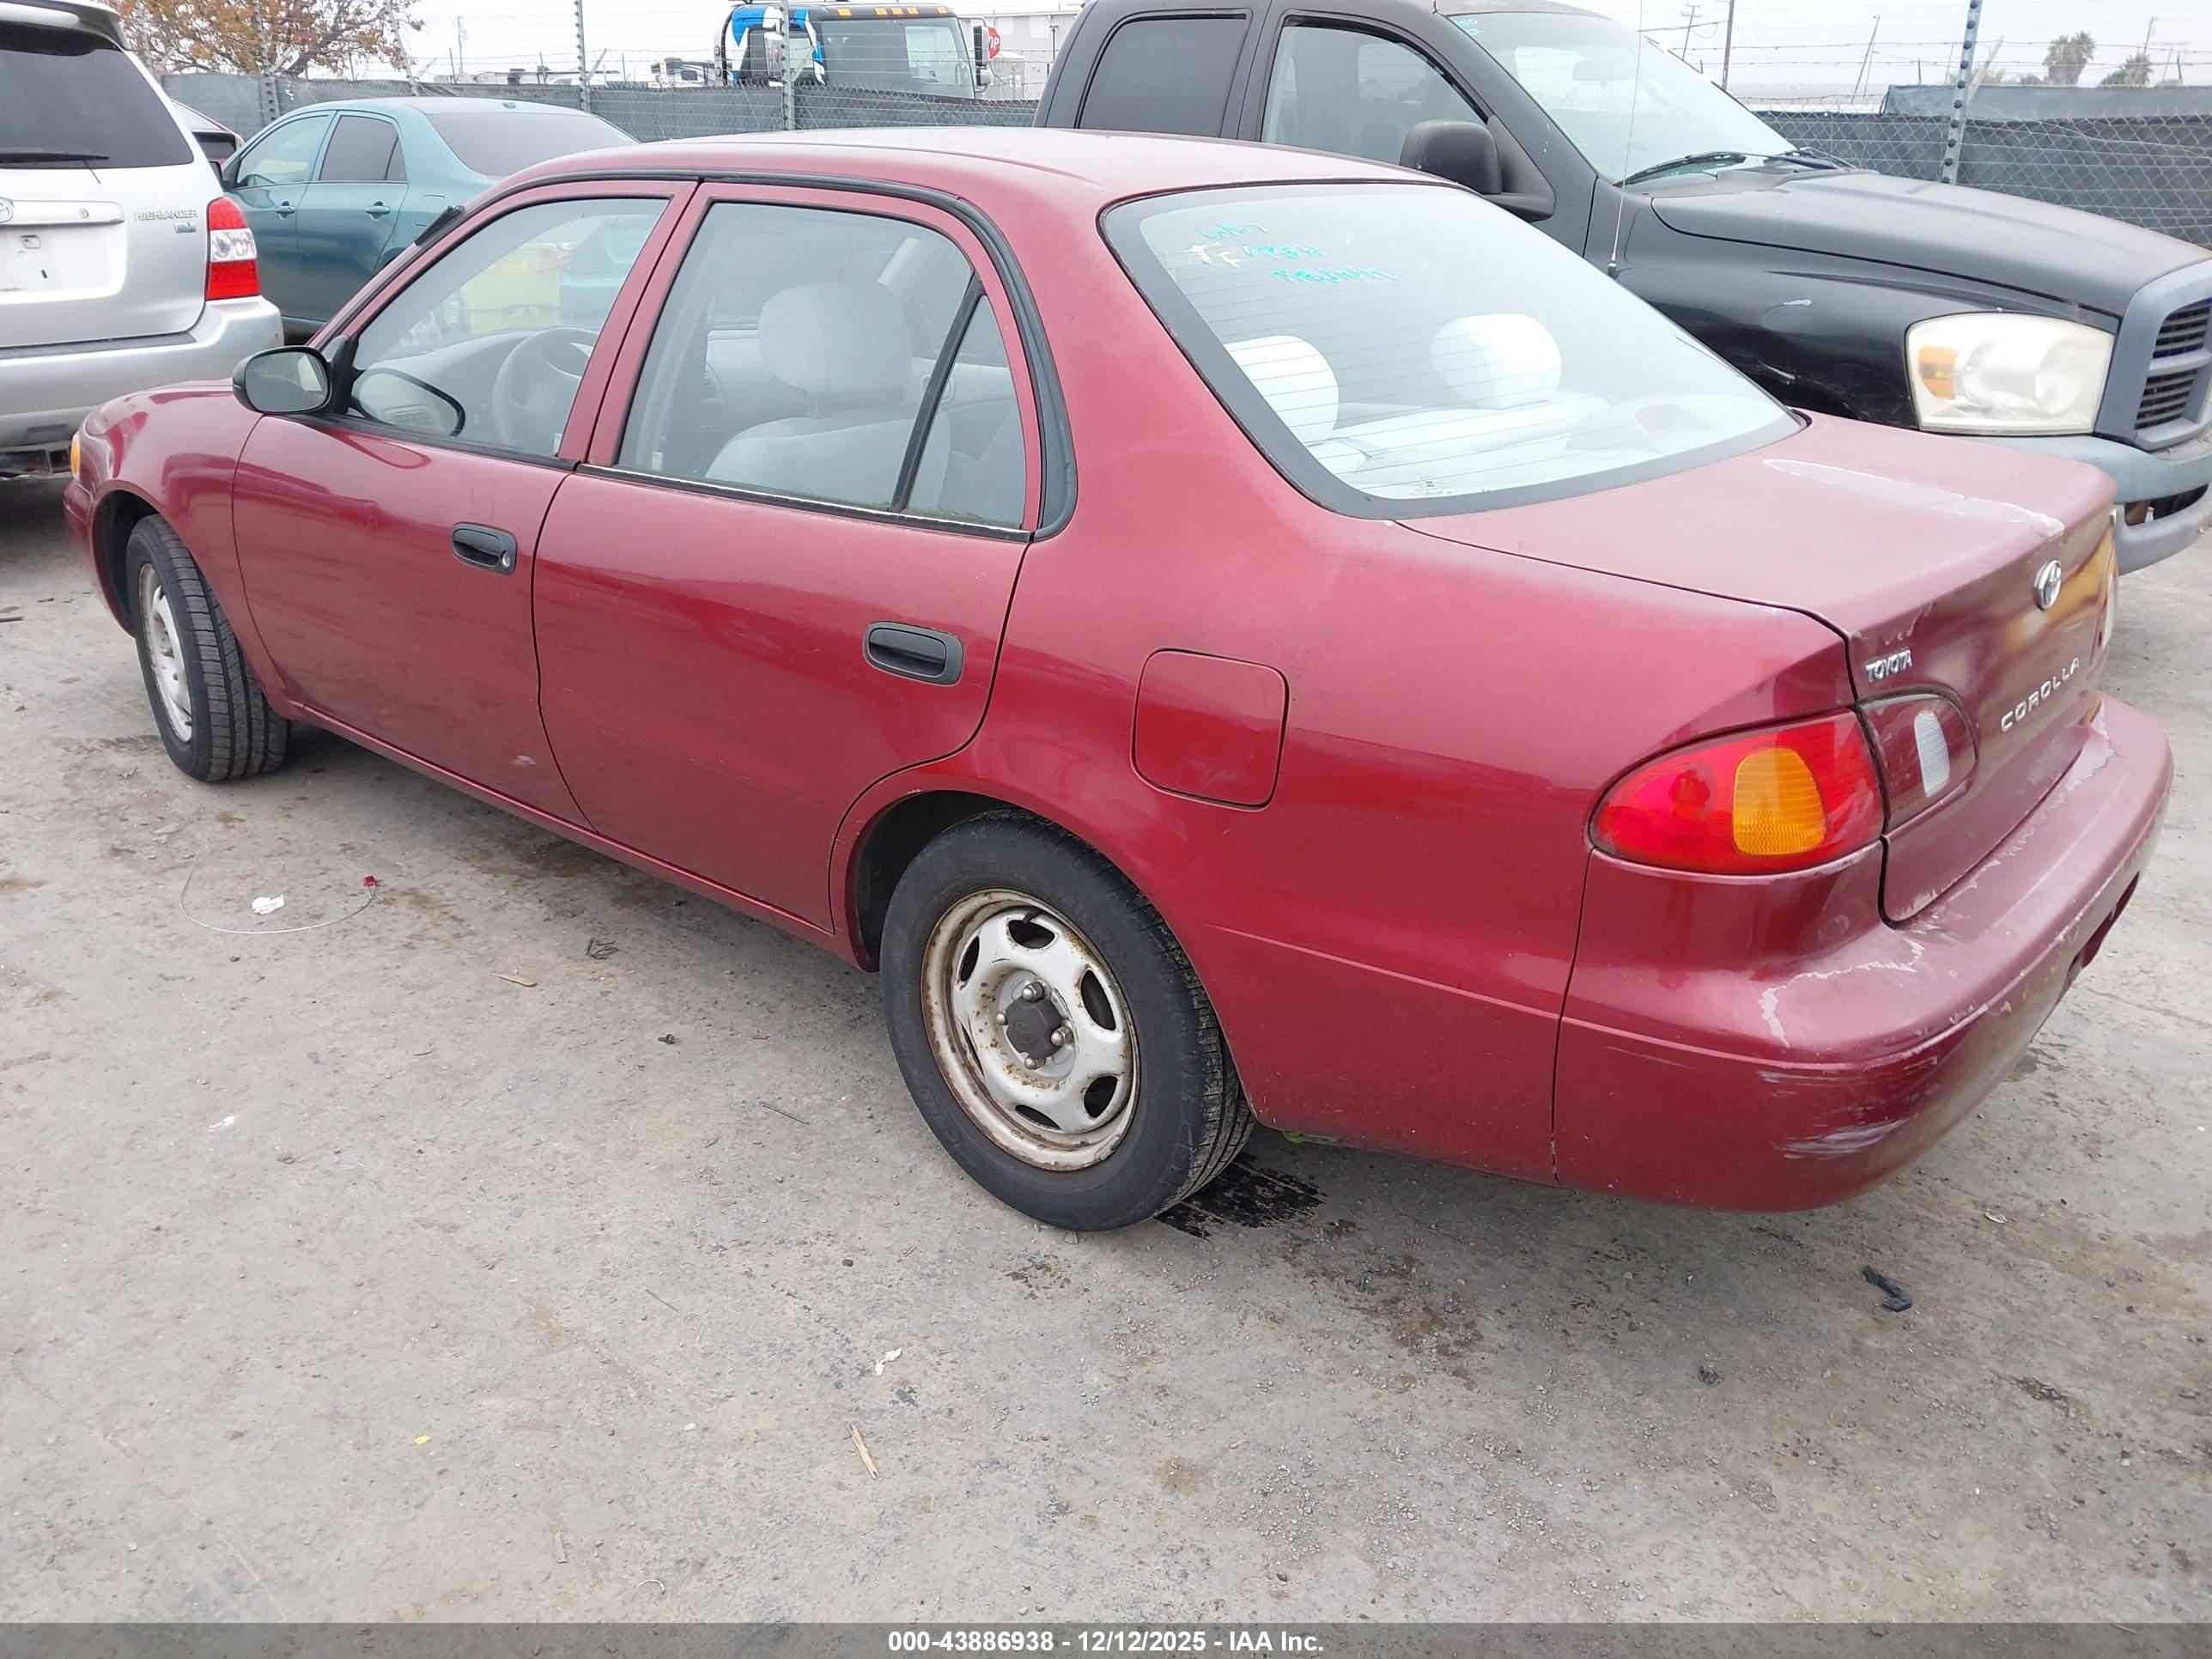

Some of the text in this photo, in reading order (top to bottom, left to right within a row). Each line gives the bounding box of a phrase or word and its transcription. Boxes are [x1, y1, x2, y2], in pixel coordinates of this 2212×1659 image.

[134, 209, 198, 221] HIGHLANDER
[1864, 648, 1913, 683] TOYOTA
[2001, 657, 2080, 732] COROLLA
